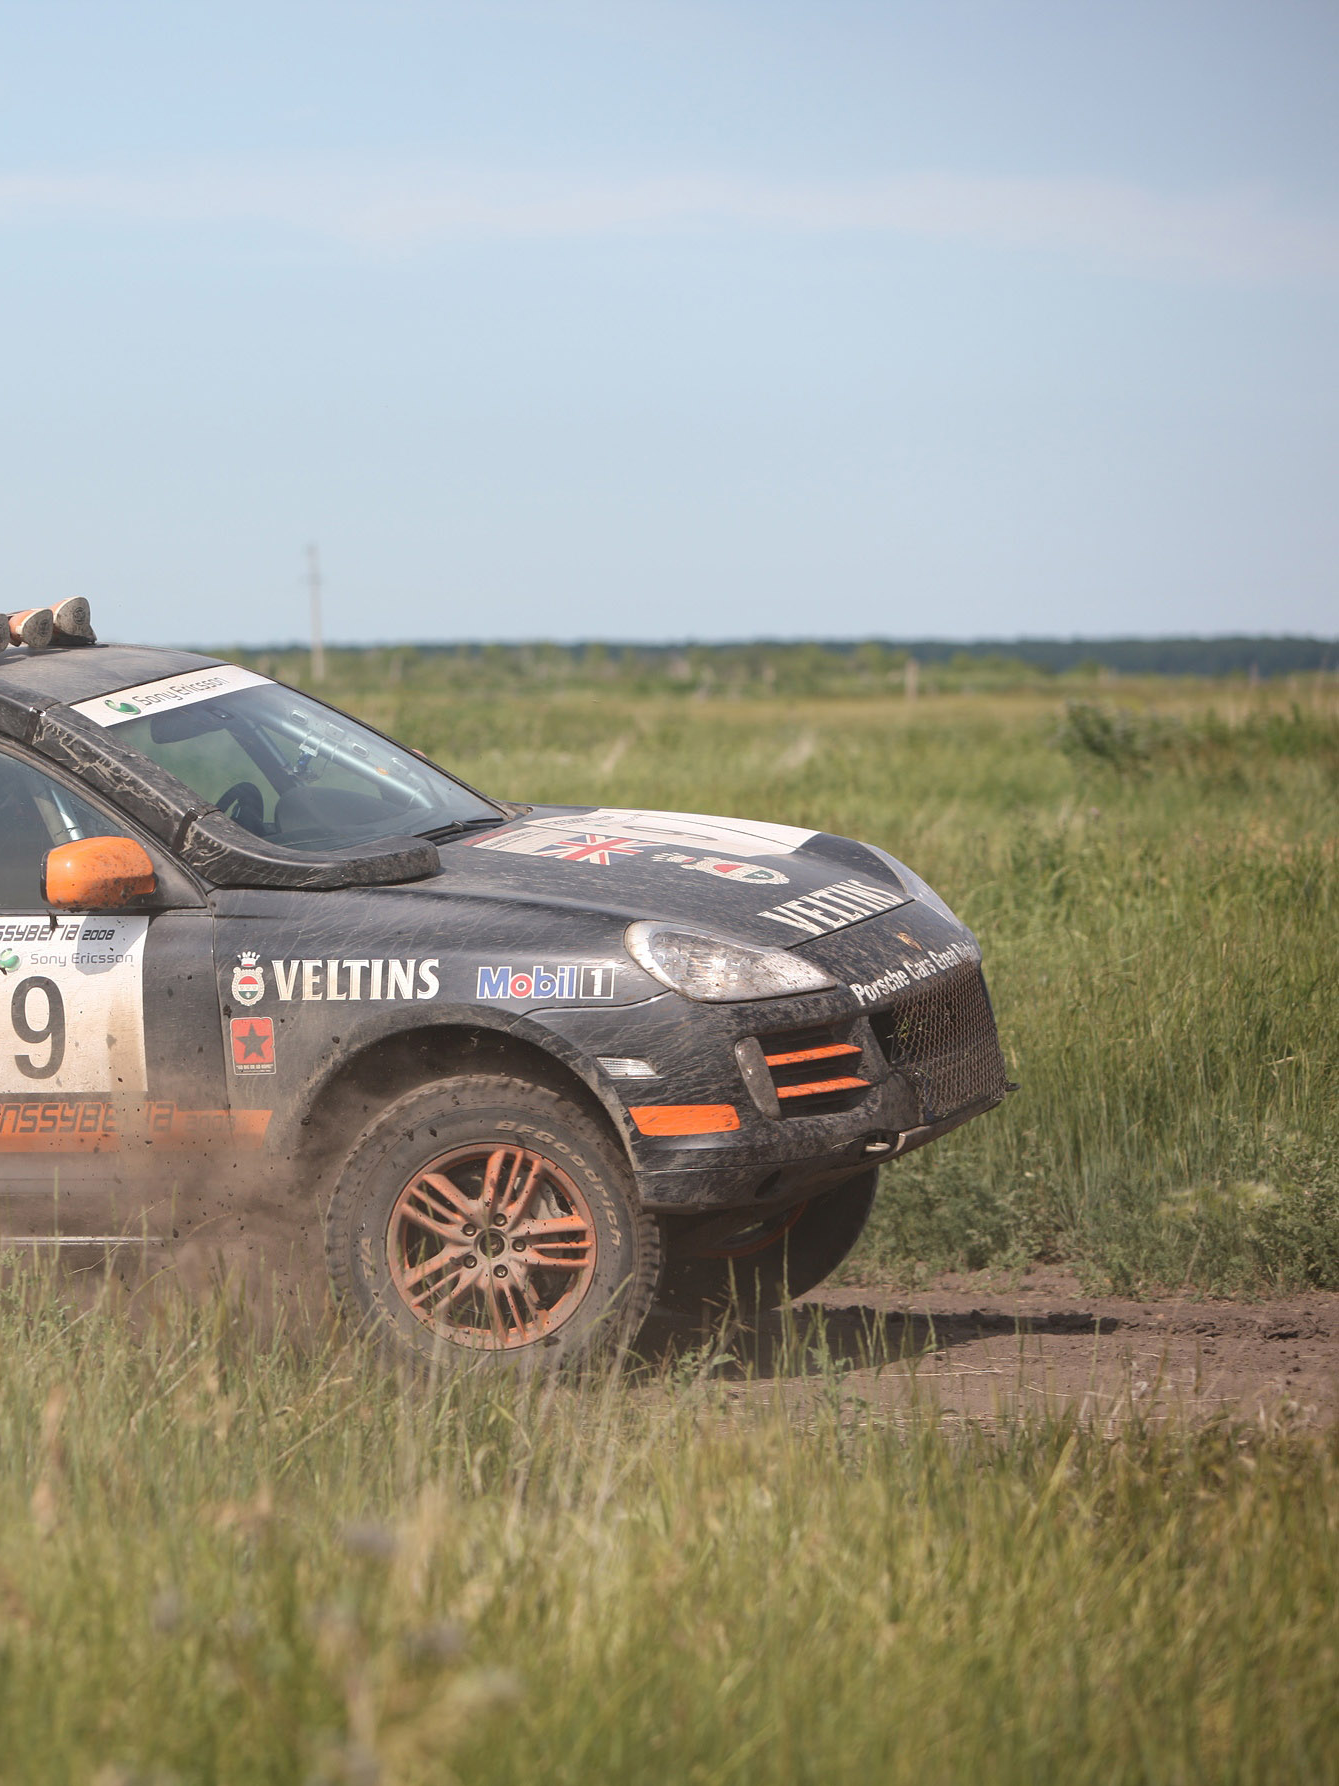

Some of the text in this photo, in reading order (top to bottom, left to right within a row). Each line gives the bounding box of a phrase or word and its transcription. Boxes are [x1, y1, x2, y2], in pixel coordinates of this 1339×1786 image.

[132, 676, 231, 706] Sony Ericsson
[757, 879, 905, 936] VELTINS
[82, 929, 116, 941] 2008
[30, 952, 134, 968] Sony Ericsson
[271, 958, 440, 1001] VELTINS
[477, 965, 578, 999] Mobil
[849, 968, 911, 1006] Porsche
[903, 958, 938, 981] Cars
[11, 975, 66, 1080] 9
